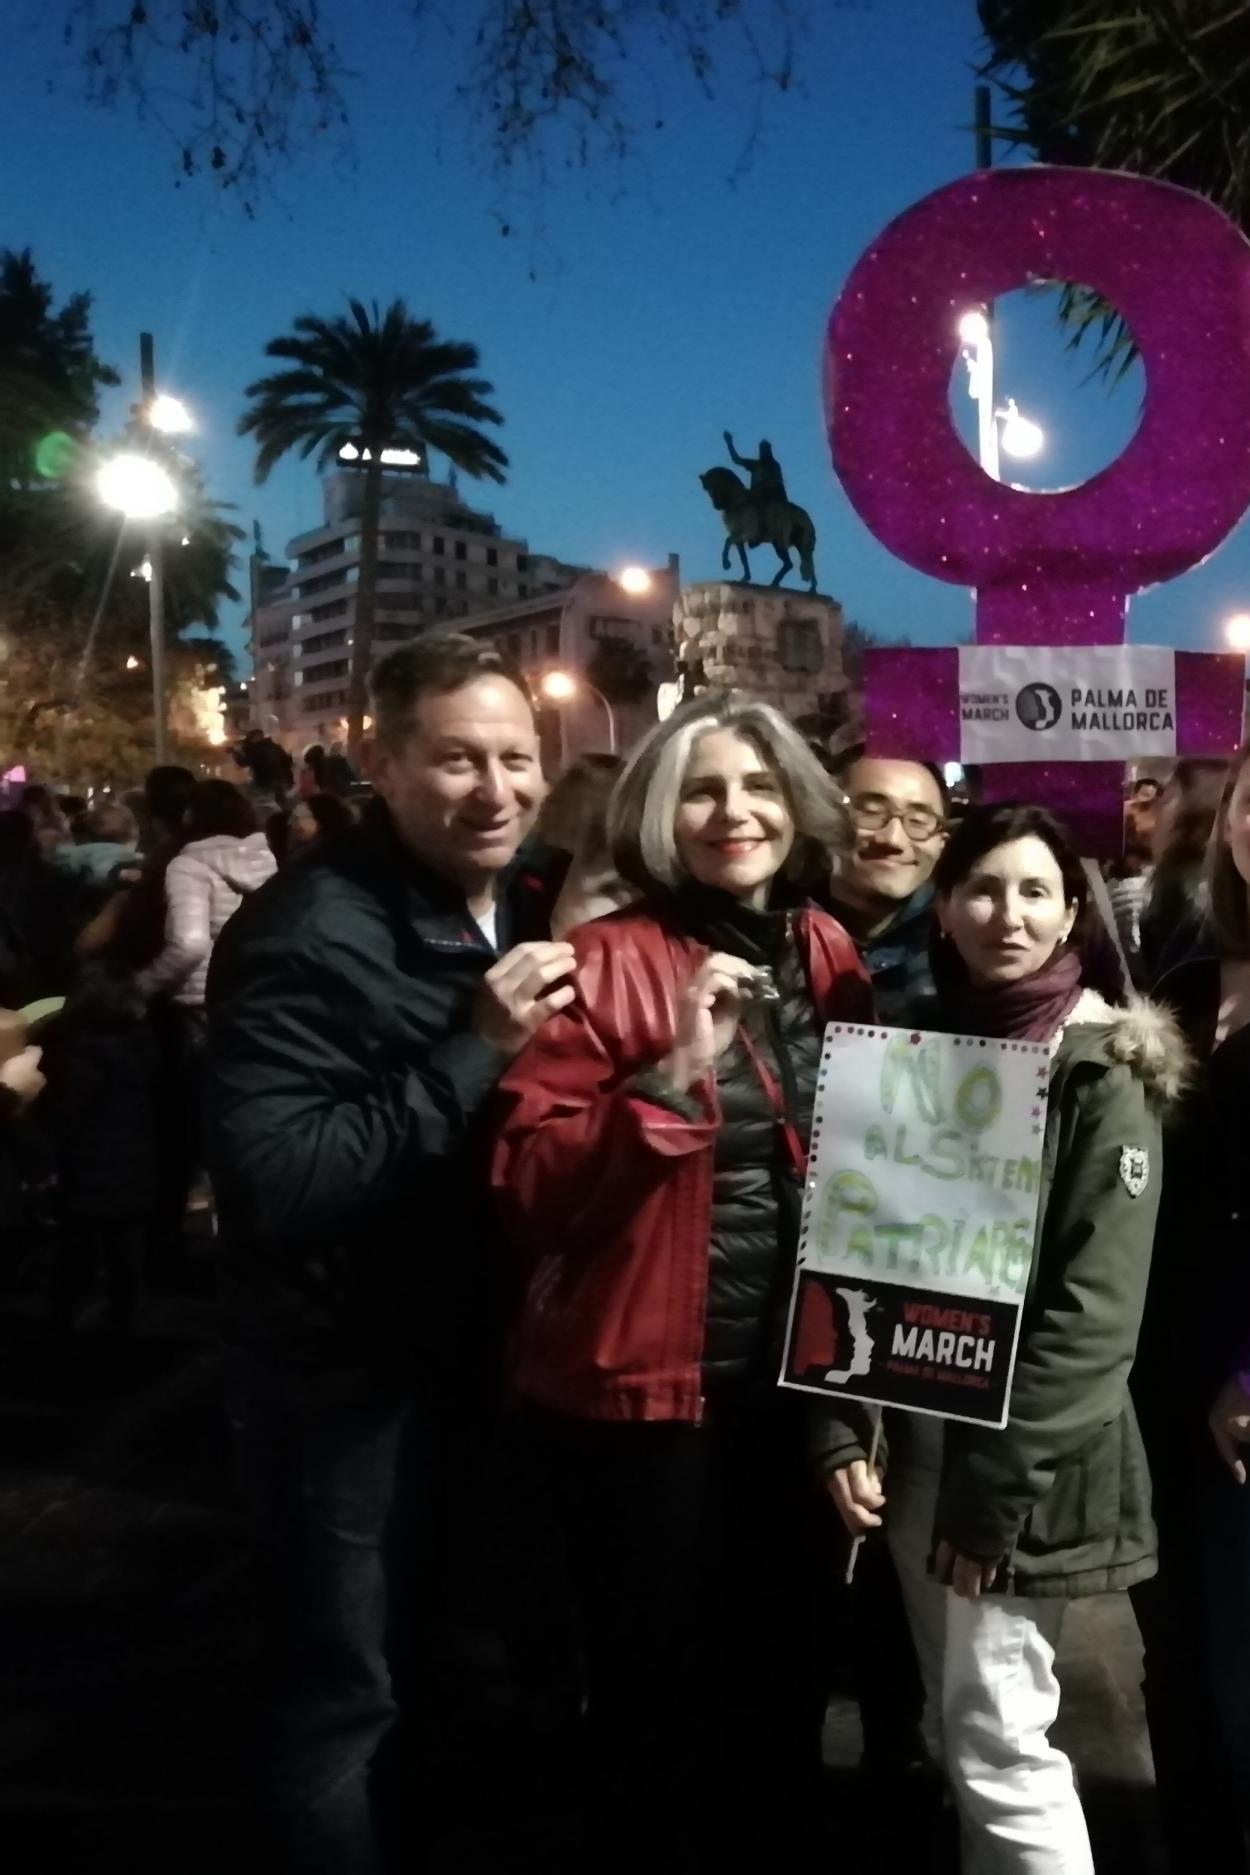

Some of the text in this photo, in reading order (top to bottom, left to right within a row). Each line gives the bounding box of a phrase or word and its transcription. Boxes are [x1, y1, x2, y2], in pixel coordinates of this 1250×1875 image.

[1071, 688, 1168, 708] PALMA DE
[962, 708, 1010, 721] MARCH
[1071, 711, 1174, 731] MALLORCA
[880, 1032, 1000, 1131] NO
[904, 1302, 992, 1336] WOMEN'S
[891, 1323, 996, 1372] MARCH
